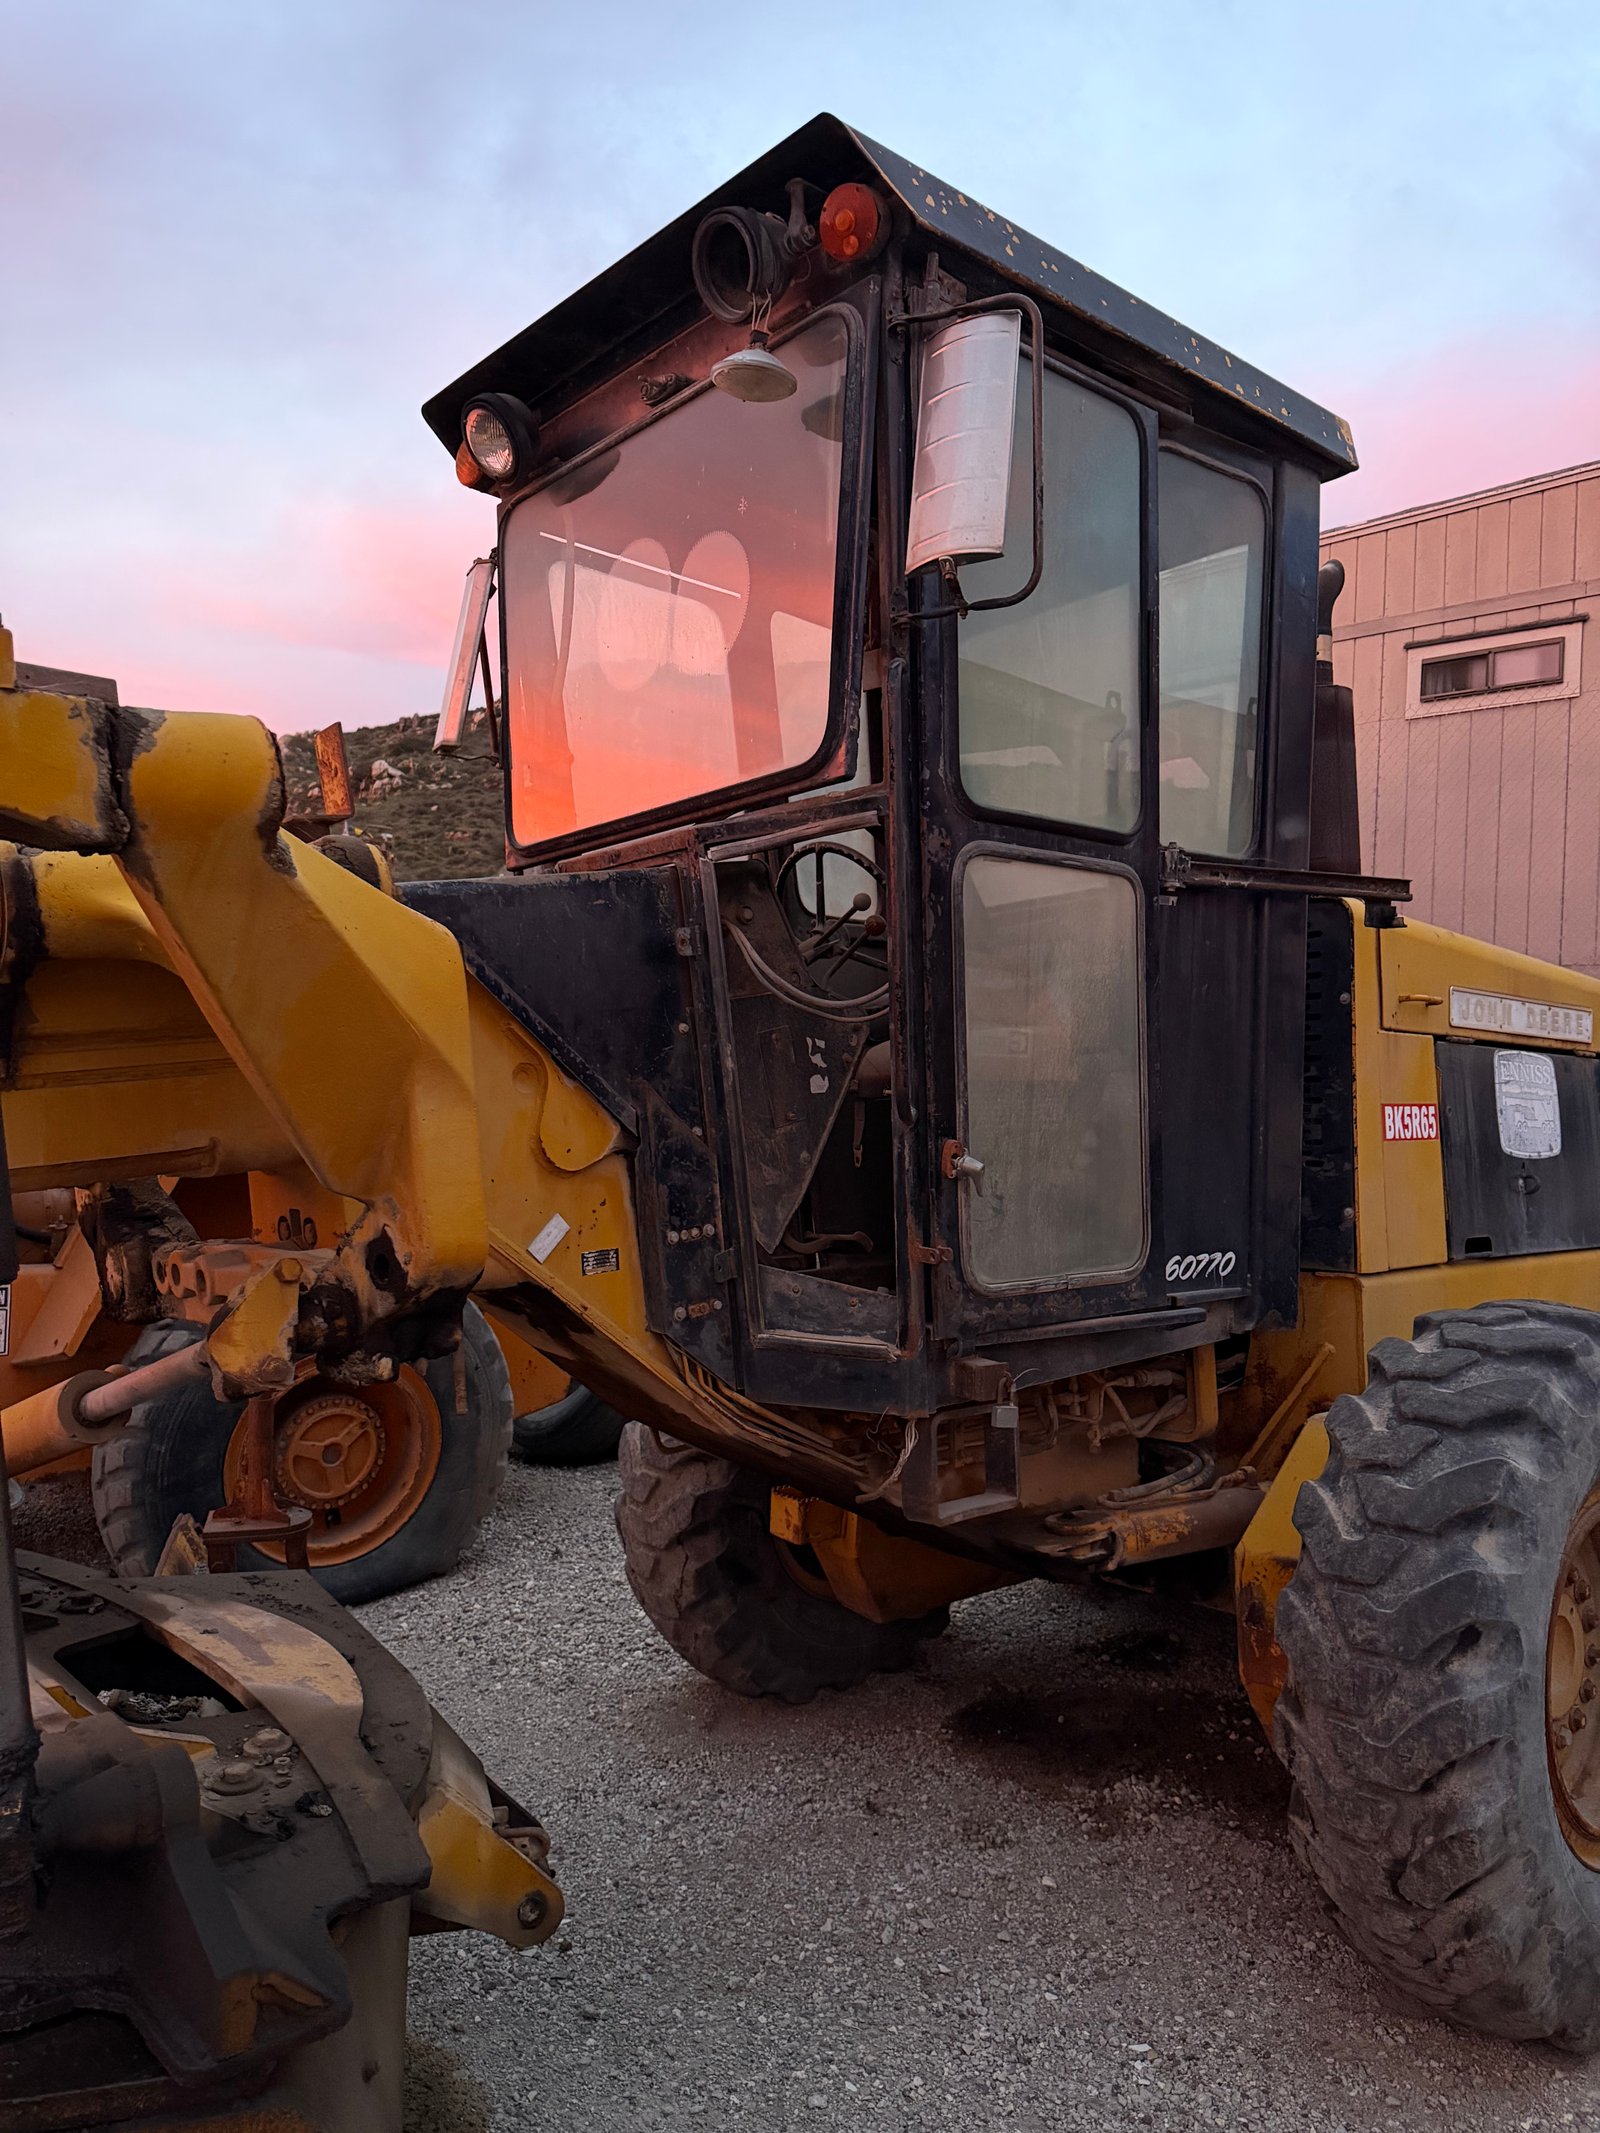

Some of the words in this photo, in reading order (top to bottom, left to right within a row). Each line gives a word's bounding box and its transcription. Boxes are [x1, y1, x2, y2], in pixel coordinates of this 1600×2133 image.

[1459, 998, 1512, 1026] JOHN
[1526, 1006, 1583, 1036] DEERE
[1500, 1060, 1551, 1085] ENNISS
[1384, 1105, 1437, 1139] BK5R65
[1165, 1251, 1236, 1281] 60770
